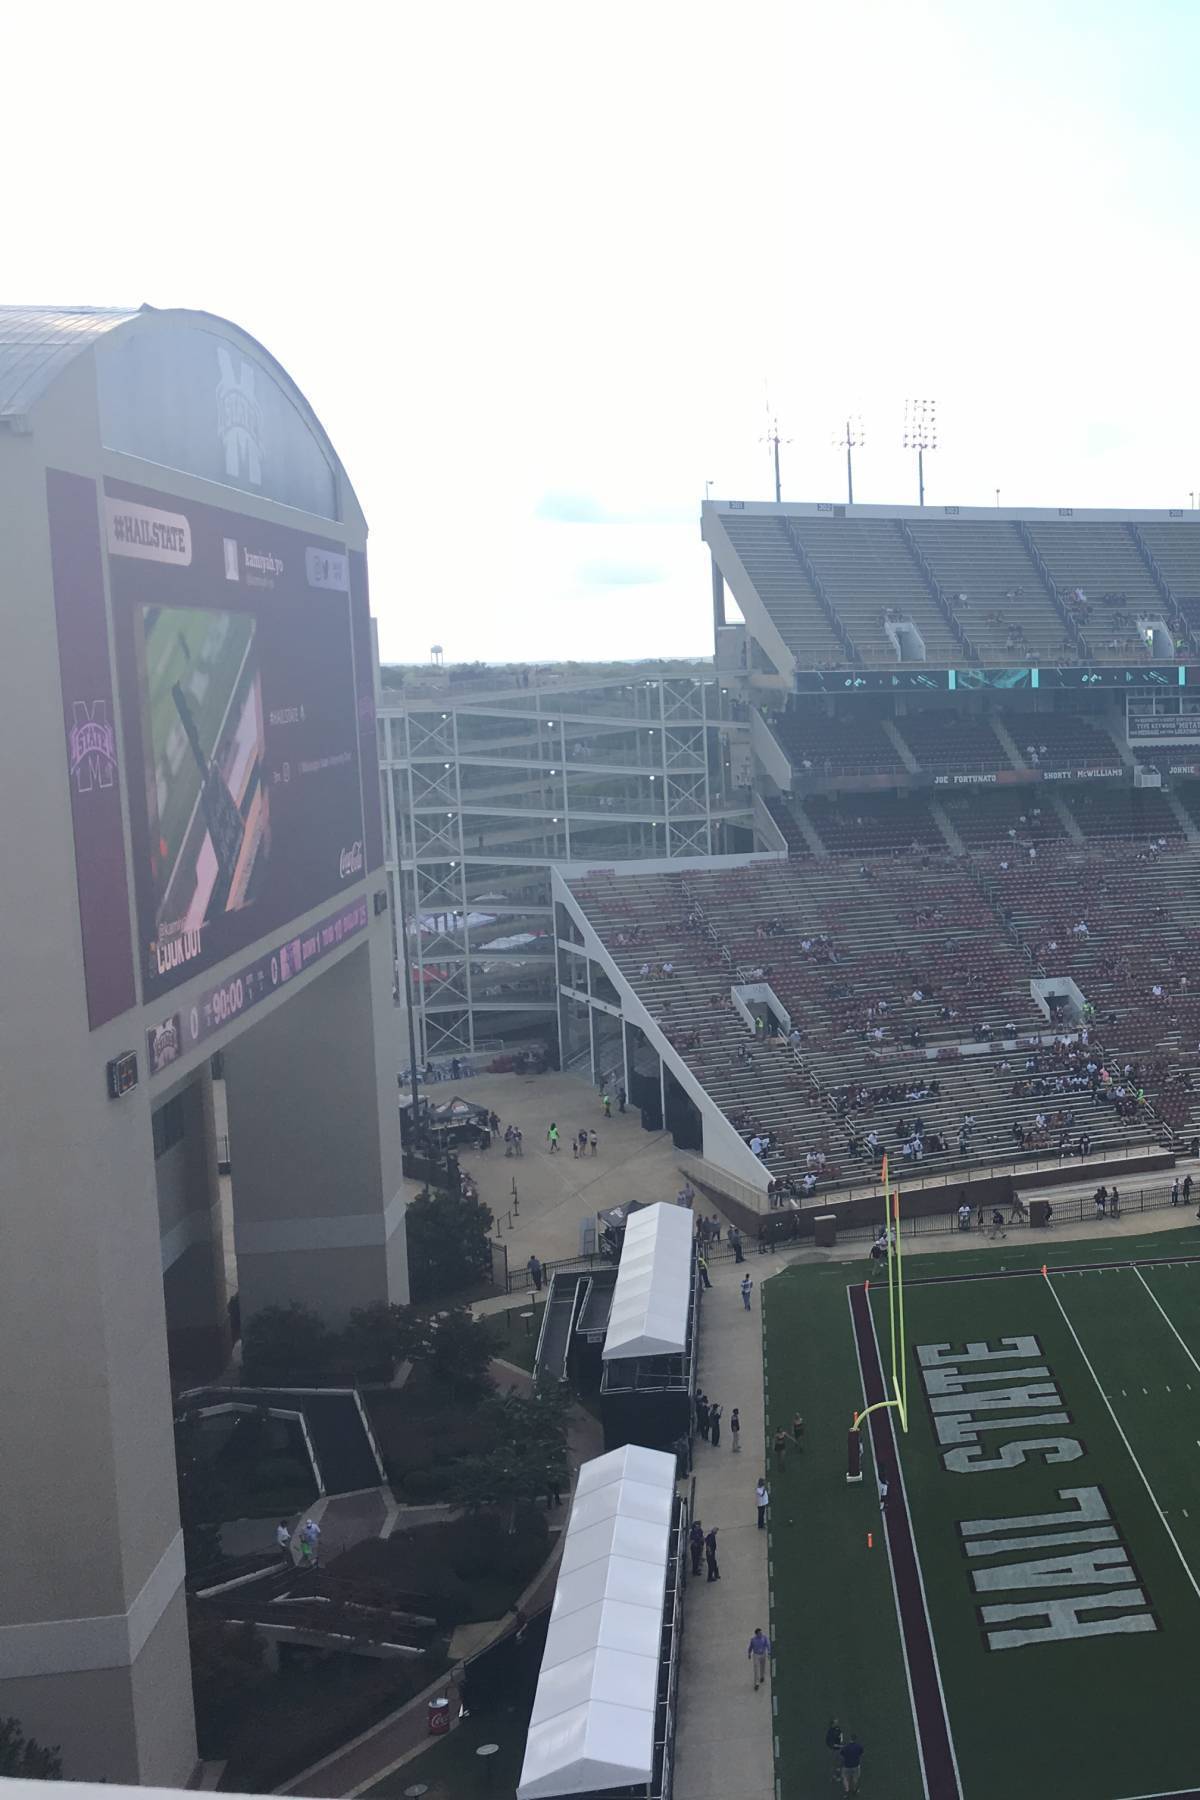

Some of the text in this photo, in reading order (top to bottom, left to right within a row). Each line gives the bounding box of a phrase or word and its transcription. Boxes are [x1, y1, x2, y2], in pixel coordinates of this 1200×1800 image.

[113, 515, 186, 553] #HAILSTATE
[934, 774, 997, 784] JOE FORTUNATO
[1043, 772, 1072, 780] SHORTY
[270, 956, 278, 985] 0
[212, 979, 243, 1024] 90:00
[190, 1006, 198, 1040] 0
[916, 1336, 1084, 1473] STATE
[960, 1486, 1158, 1650] HAIL
